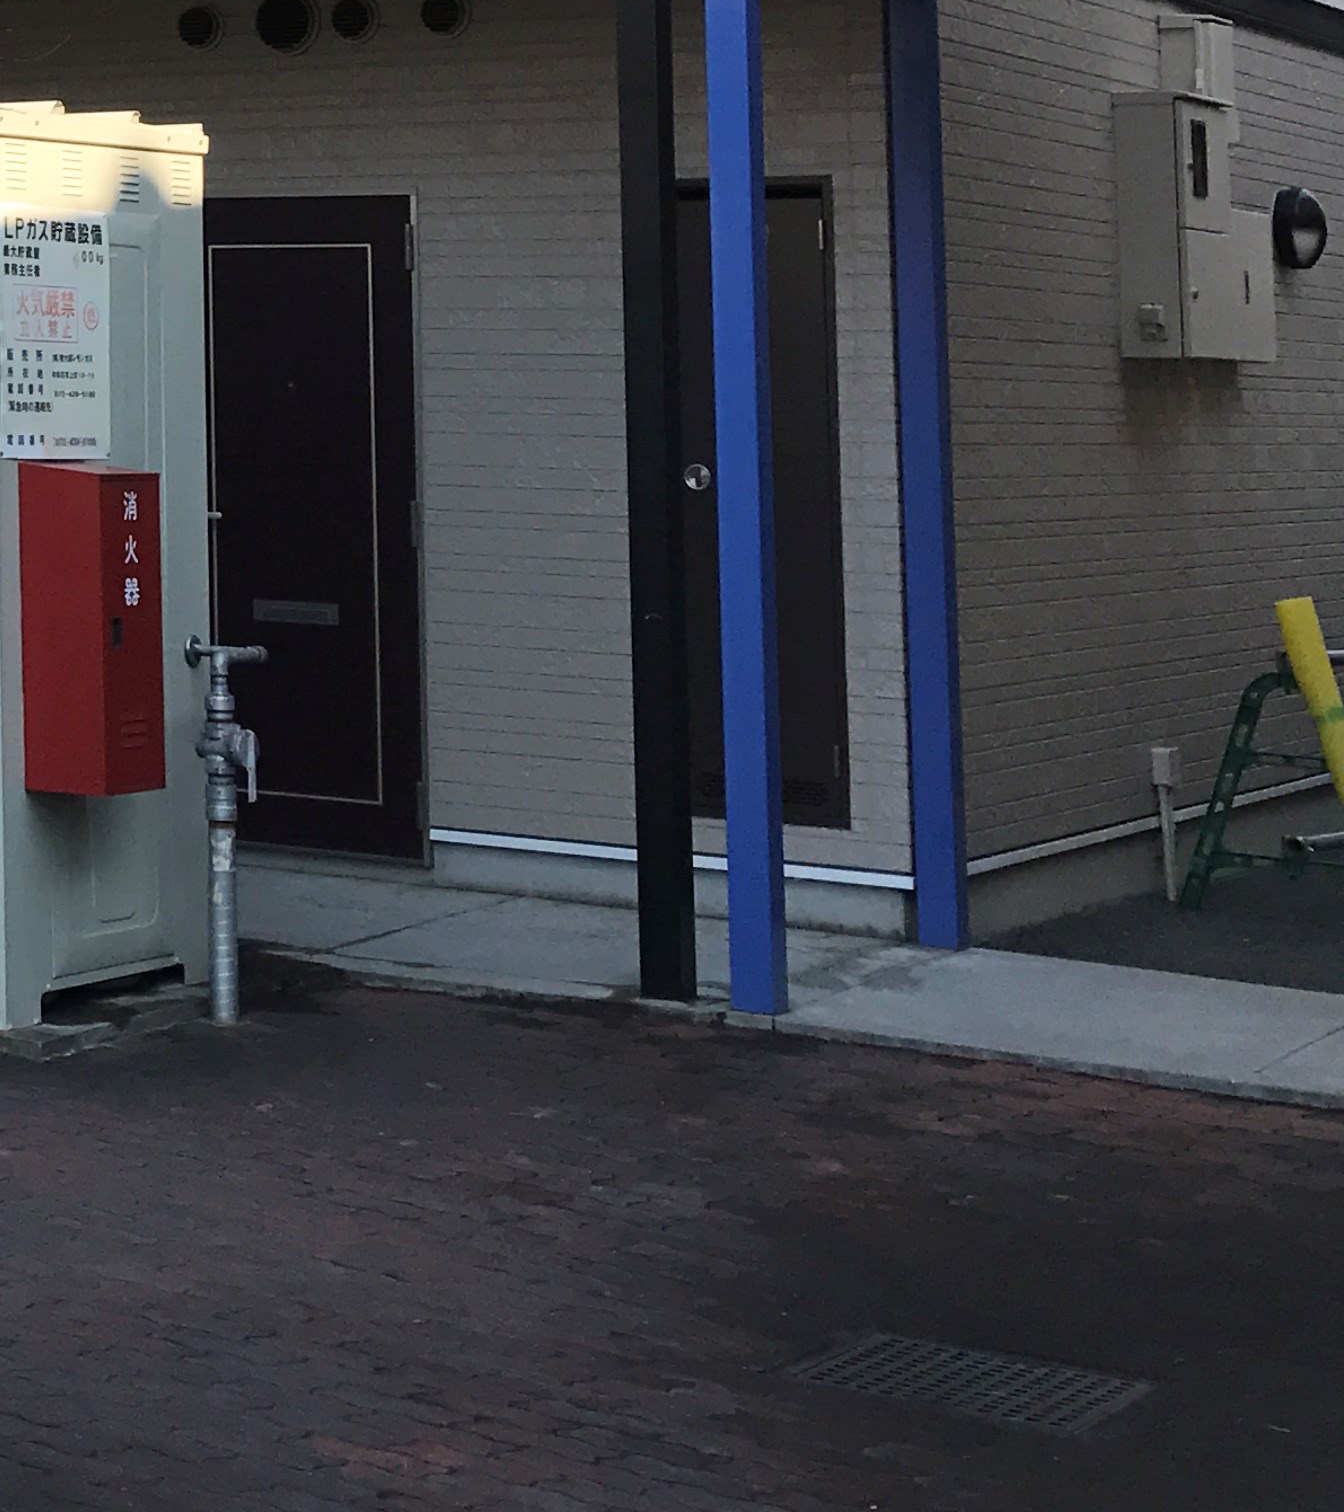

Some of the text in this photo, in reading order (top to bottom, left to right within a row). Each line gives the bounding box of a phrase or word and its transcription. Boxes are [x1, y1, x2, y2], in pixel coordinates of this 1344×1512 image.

[4, 216, 103, 245] LPガス貯蔵設備
[16, 289, 75, 318] 火気厳禁
[19, 319, 72, 339] 立入禁止
[123, 491, 140, 606] 消火器
